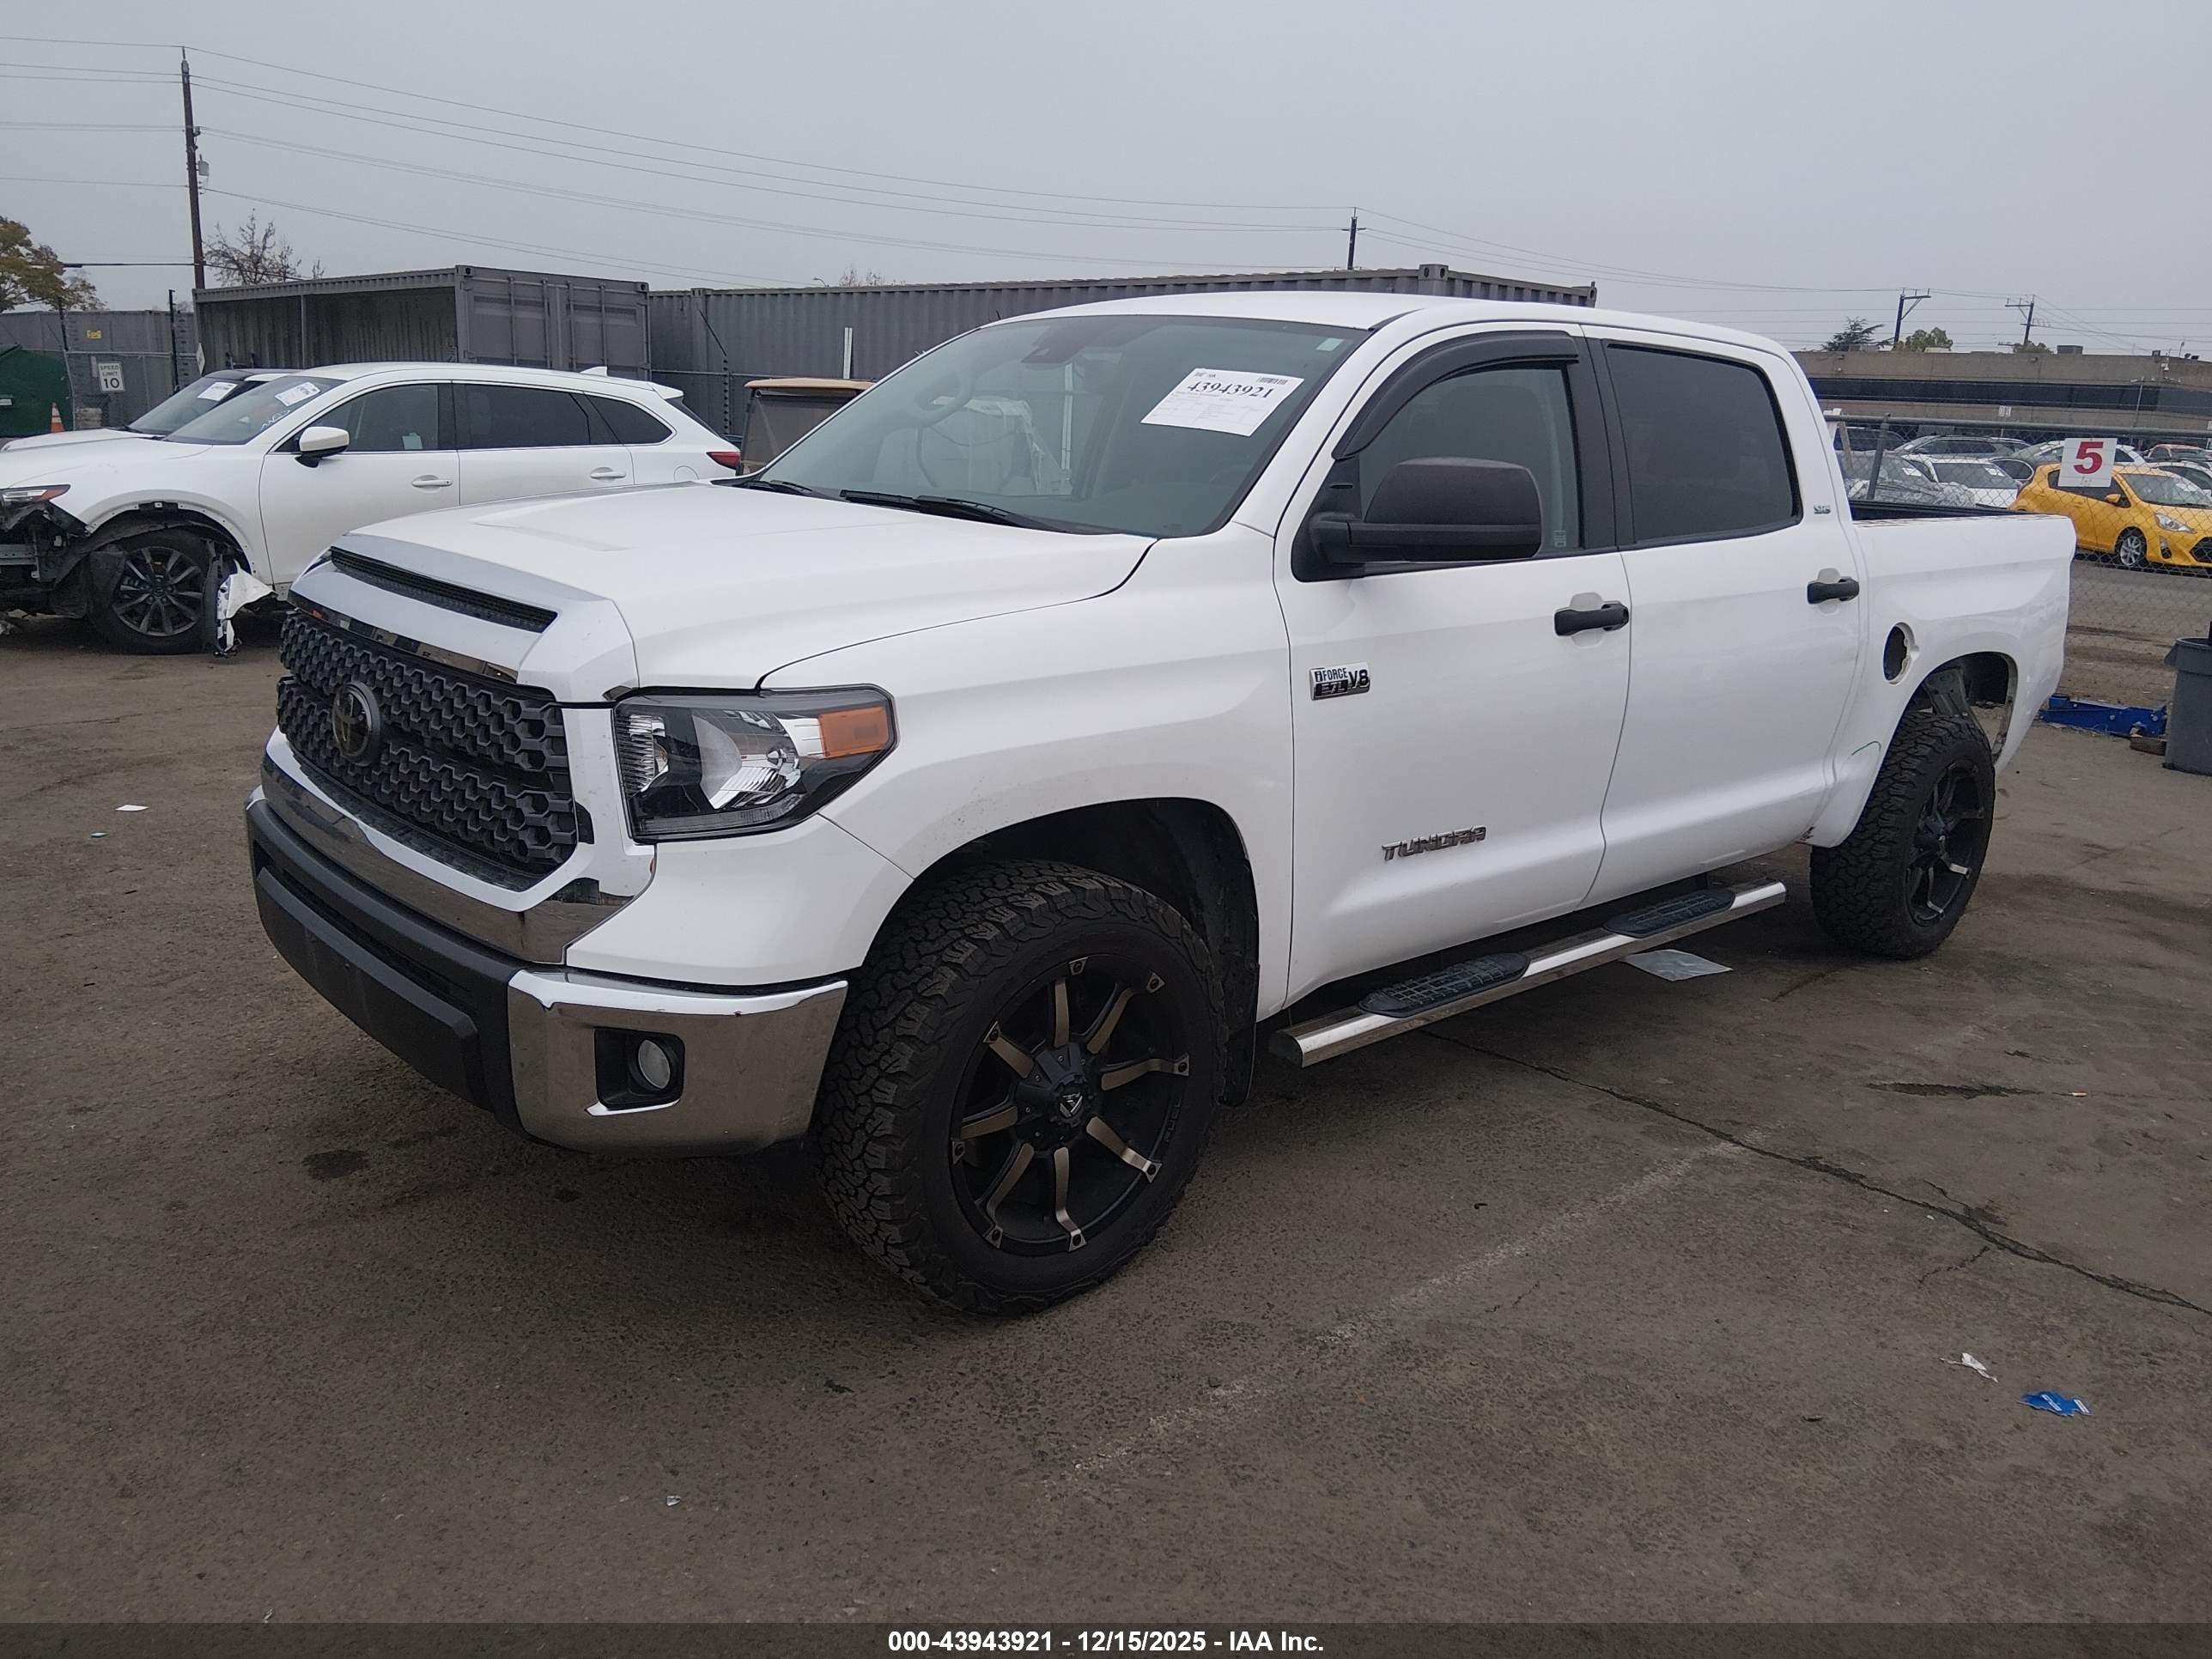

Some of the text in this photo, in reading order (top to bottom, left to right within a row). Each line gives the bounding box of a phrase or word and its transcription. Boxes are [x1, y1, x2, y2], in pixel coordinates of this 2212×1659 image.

[103, 377, 120, 389] 10
[1188, 380, 1273, 398] 43943921
[2074, 441, 2104, 475] 5
[1348, 669, 1370, 688] V8
[1381, 824, 1487, 861] TUNDRA
